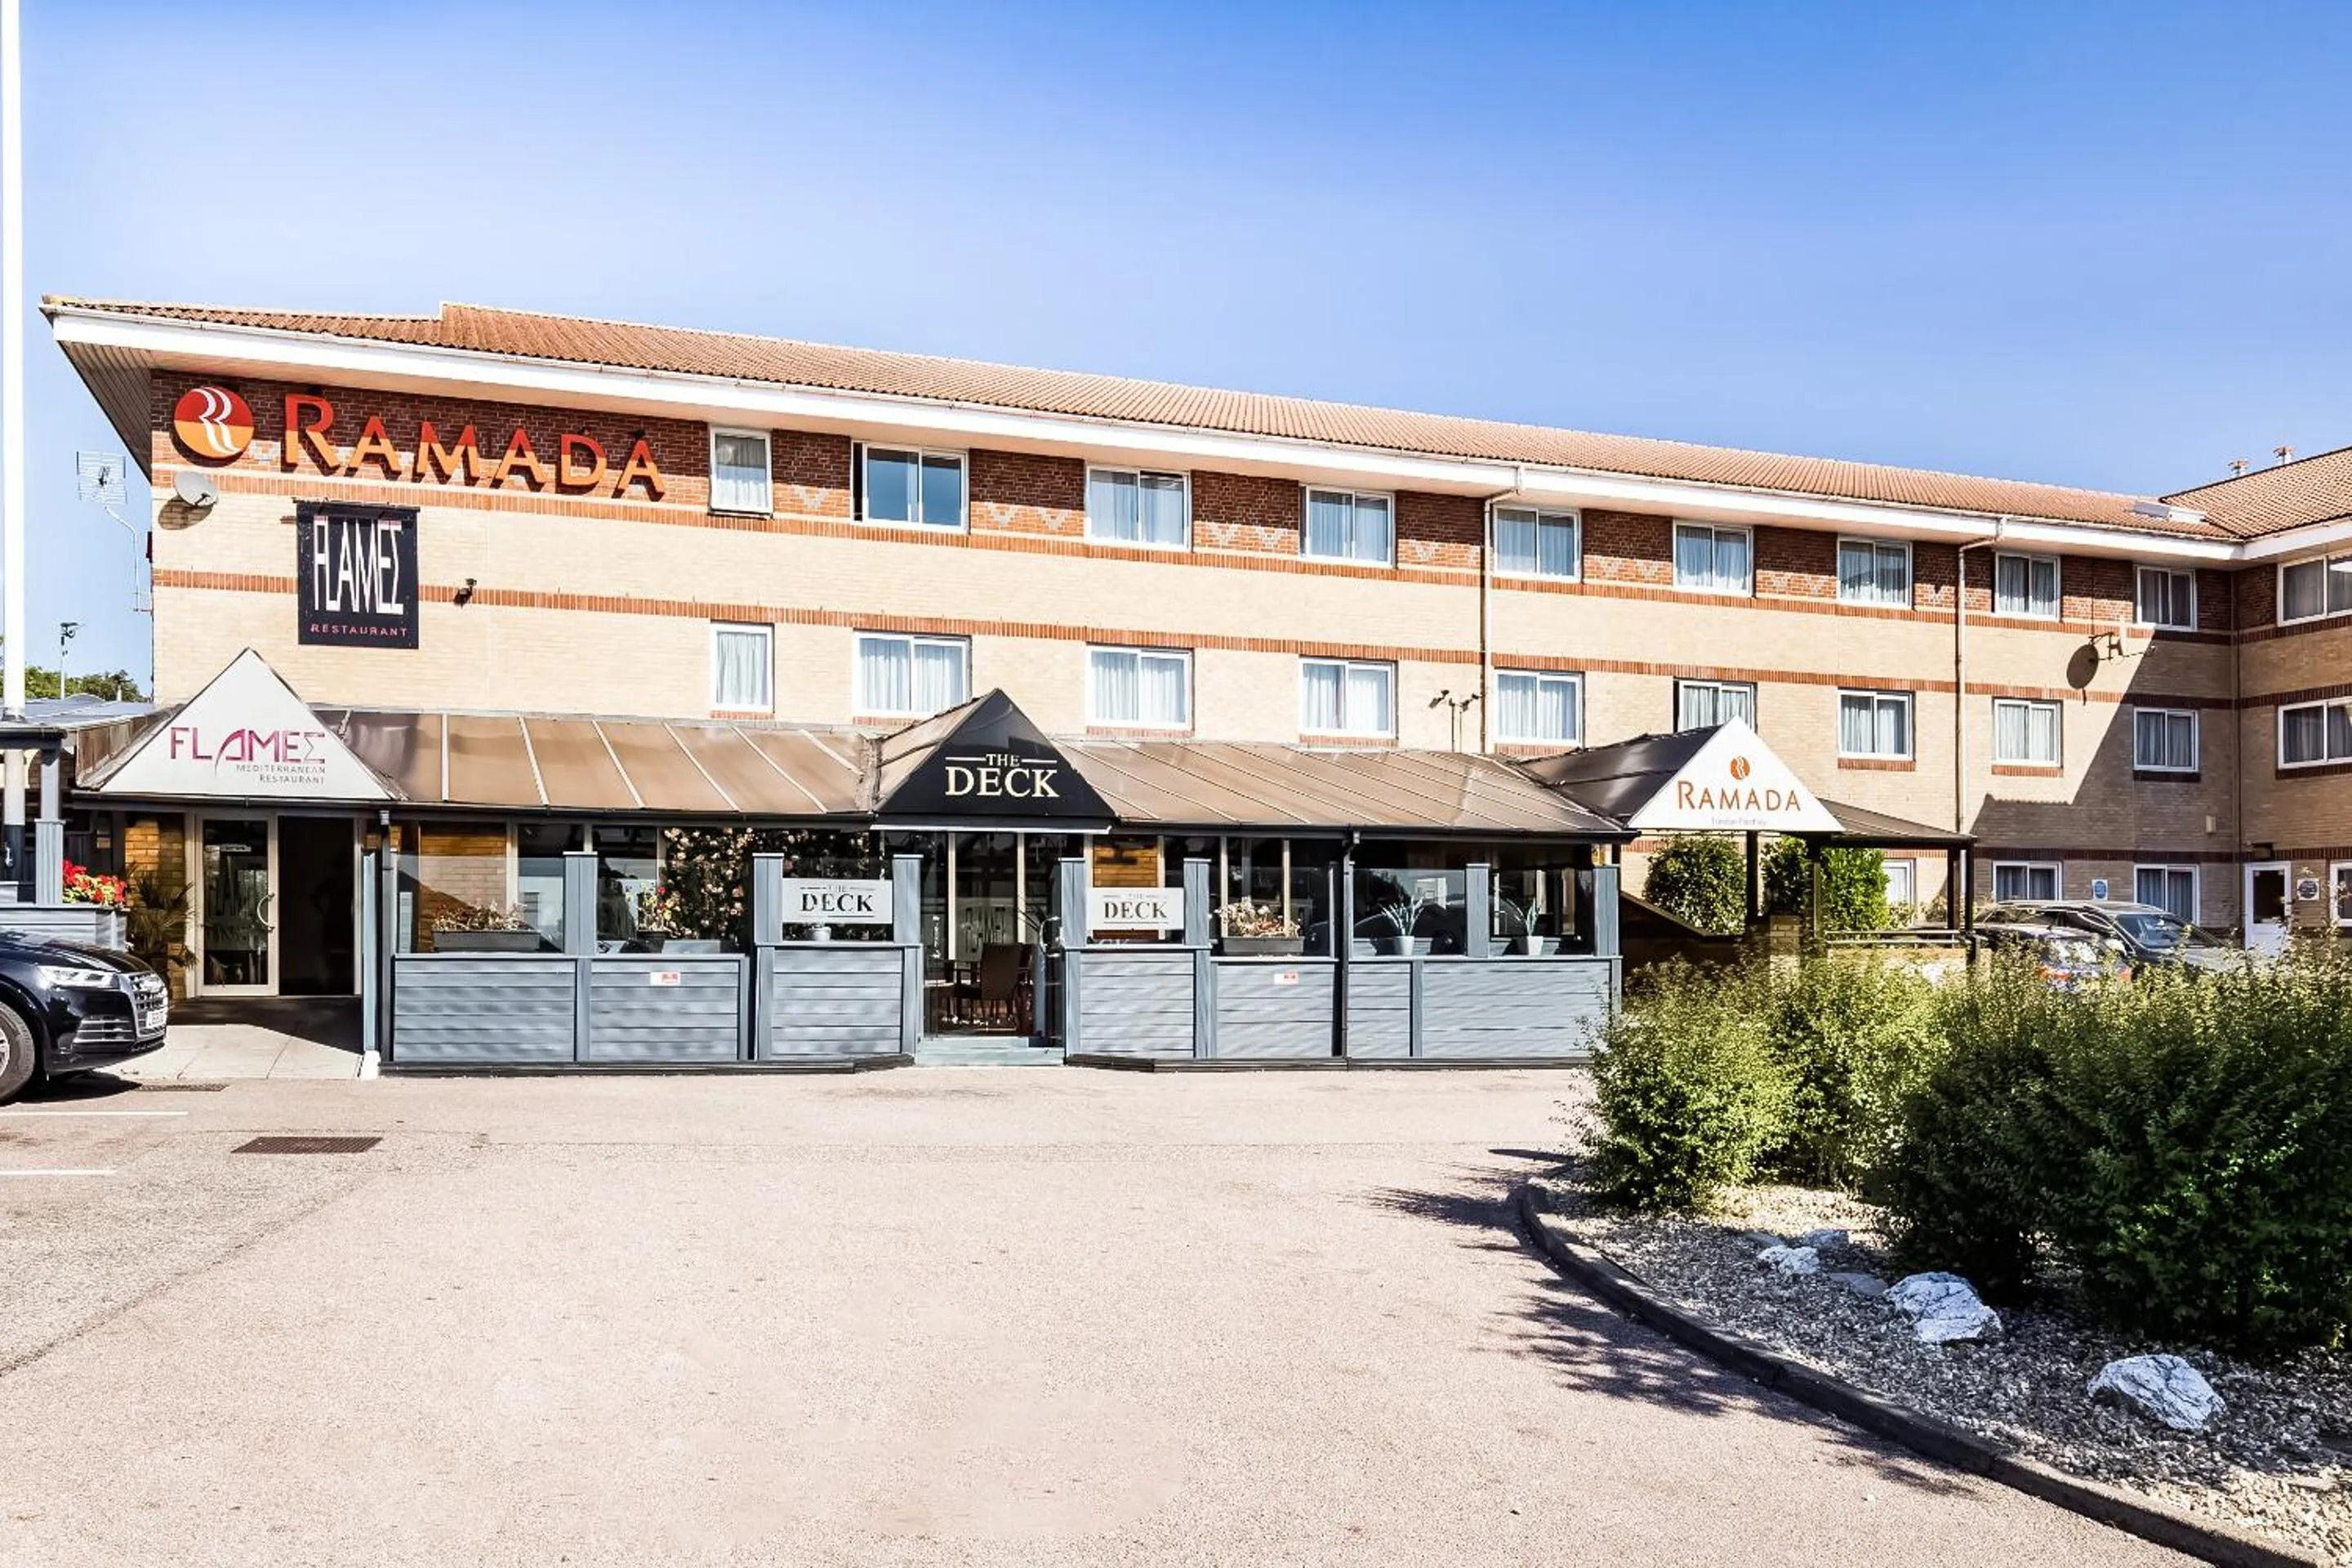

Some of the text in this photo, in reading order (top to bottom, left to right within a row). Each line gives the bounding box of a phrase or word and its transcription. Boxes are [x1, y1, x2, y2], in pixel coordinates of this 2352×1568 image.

[284, 394, 666, 495] RAMADA
[310, 623, 408, 637] RESTAURANT
[986, 754, 1020, 766] THE
[236, 764, 326, 774] MEDITERRANEAN
[260, 774, 324, 784] RESTAURANT
[945, 766, 1060, 798] DECK
[1677, 781, 1802, 811] RAMADA
[800, 893, 873, 911] DECK
[1104, 902, 1168, 919] DECK
